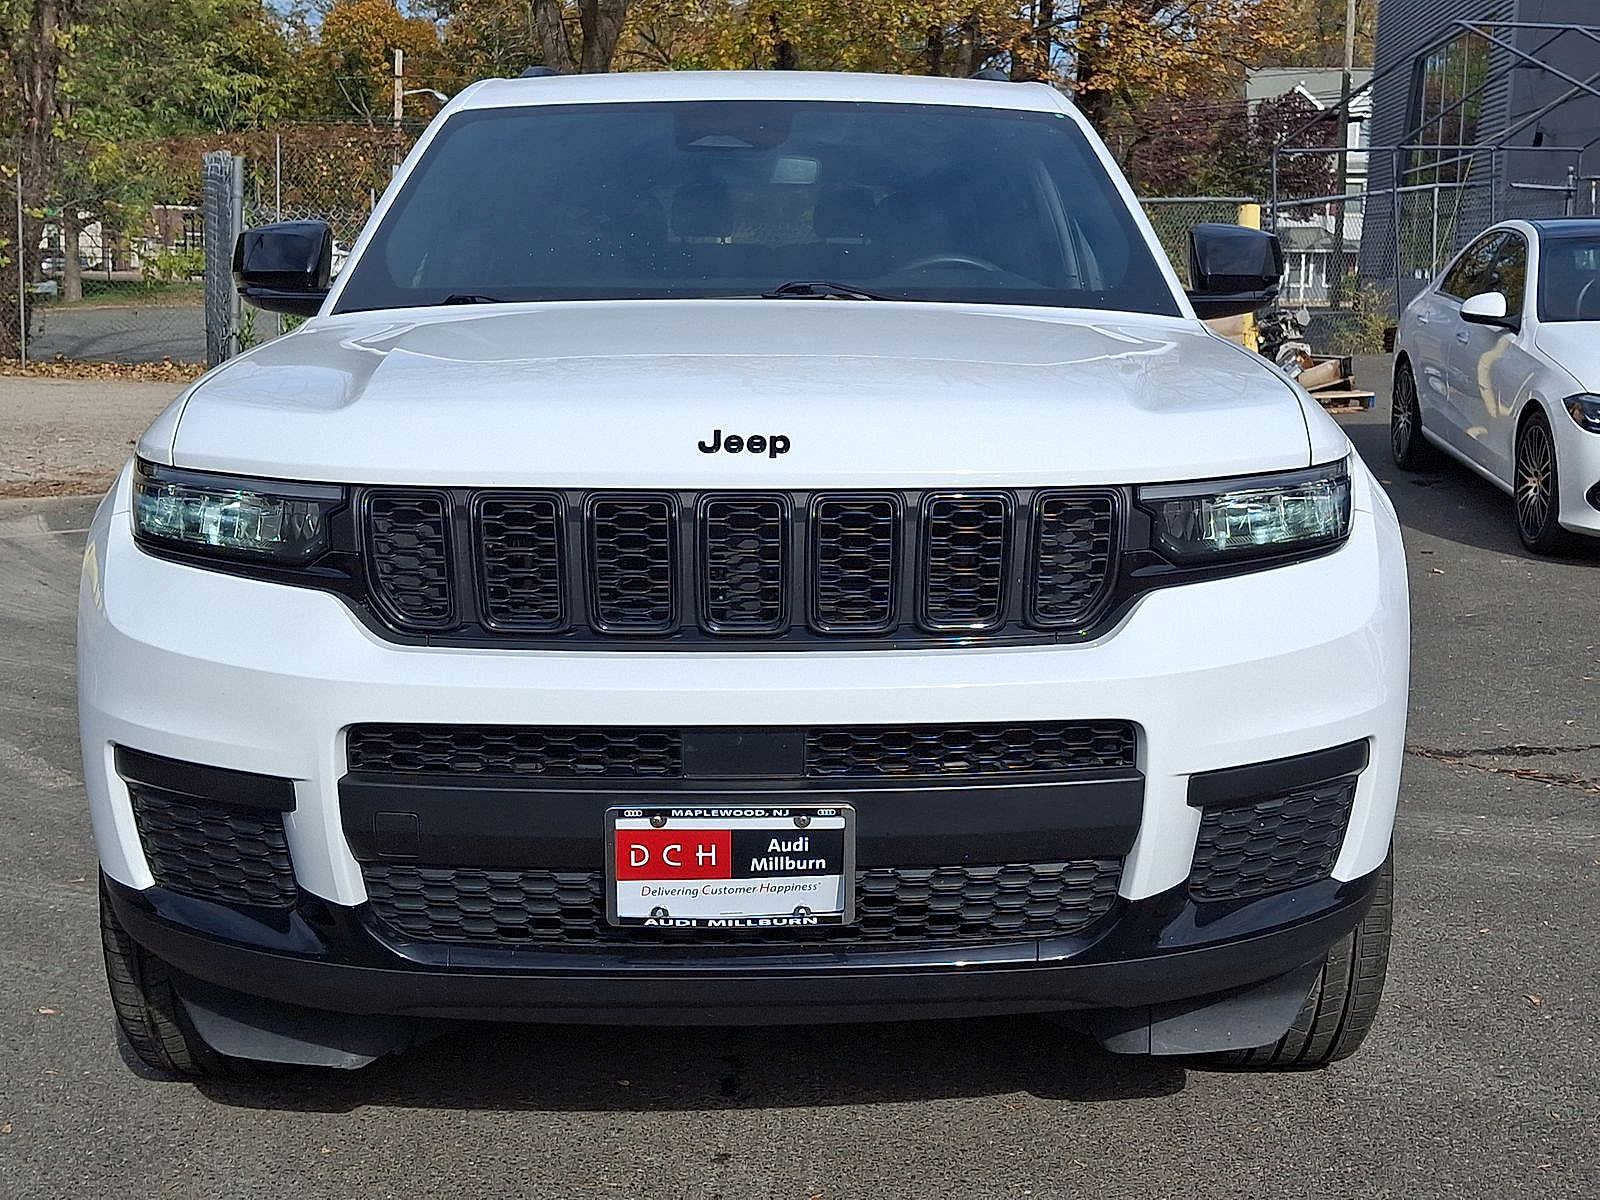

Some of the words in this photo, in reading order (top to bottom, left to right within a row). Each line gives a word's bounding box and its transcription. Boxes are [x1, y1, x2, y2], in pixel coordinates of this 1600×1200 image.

[698, 430, 790, 458] Jeep
[773, 809, 790, 817] NJ
[767, 837, 809, 852] Audi
[750, 856, 826, 872] Millburn
[641, 886, 699, 898] Delivering
[702, 884, 757, 896] Customer
[644, 918, 697, 927] AUDI
[708, 917, 818, 927] MILLBURN
